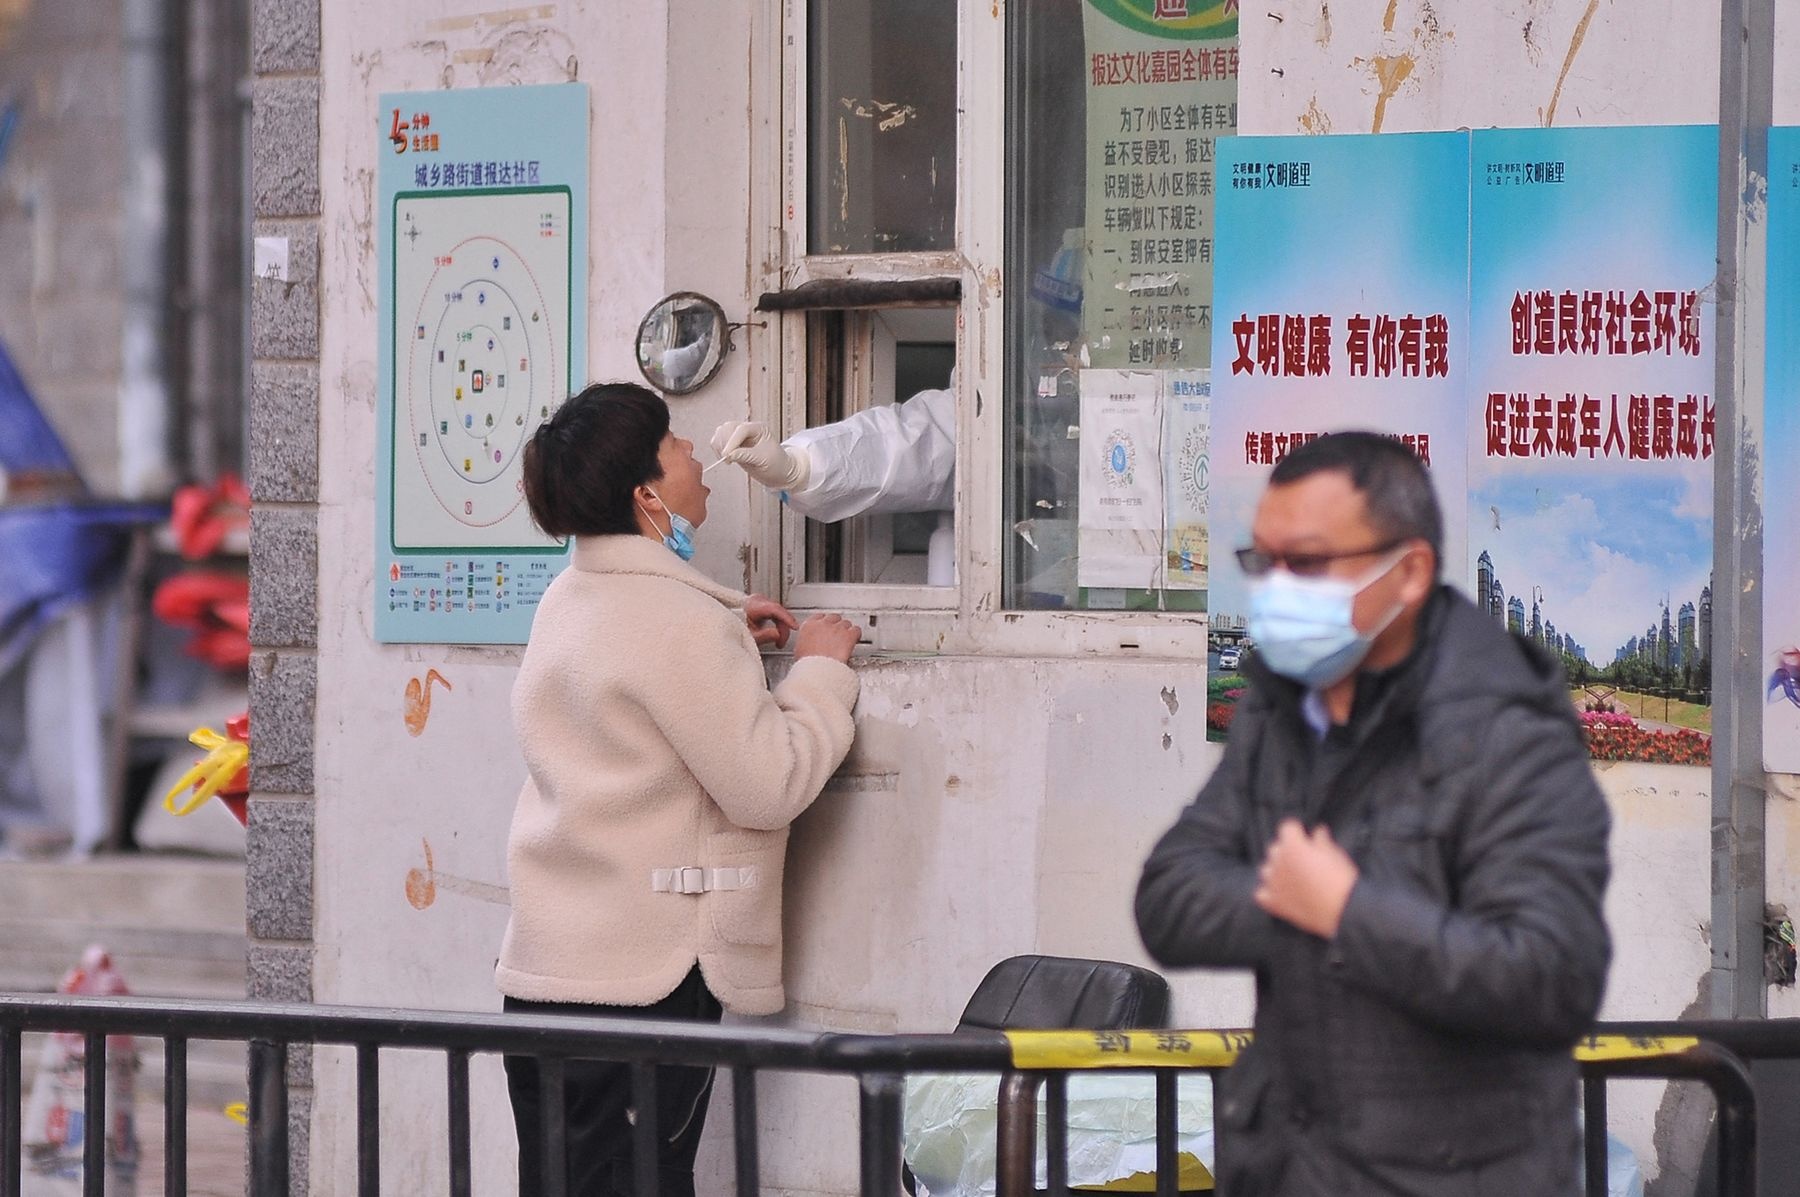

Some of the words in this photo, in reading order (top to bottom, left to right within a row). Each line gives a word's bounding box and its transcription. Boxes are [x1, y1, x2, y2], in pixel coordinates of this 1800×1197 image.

[415, 161, 540, 188] 城乡路街道报达社区
[1266, 161, 1311, 188] 文明道里
[1525, 161, 1565, 184] 文明道里
[1232, 313, 1331, 377] 文明健康
[1346, 313, 1449, 378] 有你有我
[1511, 290, 1700, 356] 创造良好社会环境
[1485, 393, 1715, 460] 促进未成年人健康成长
